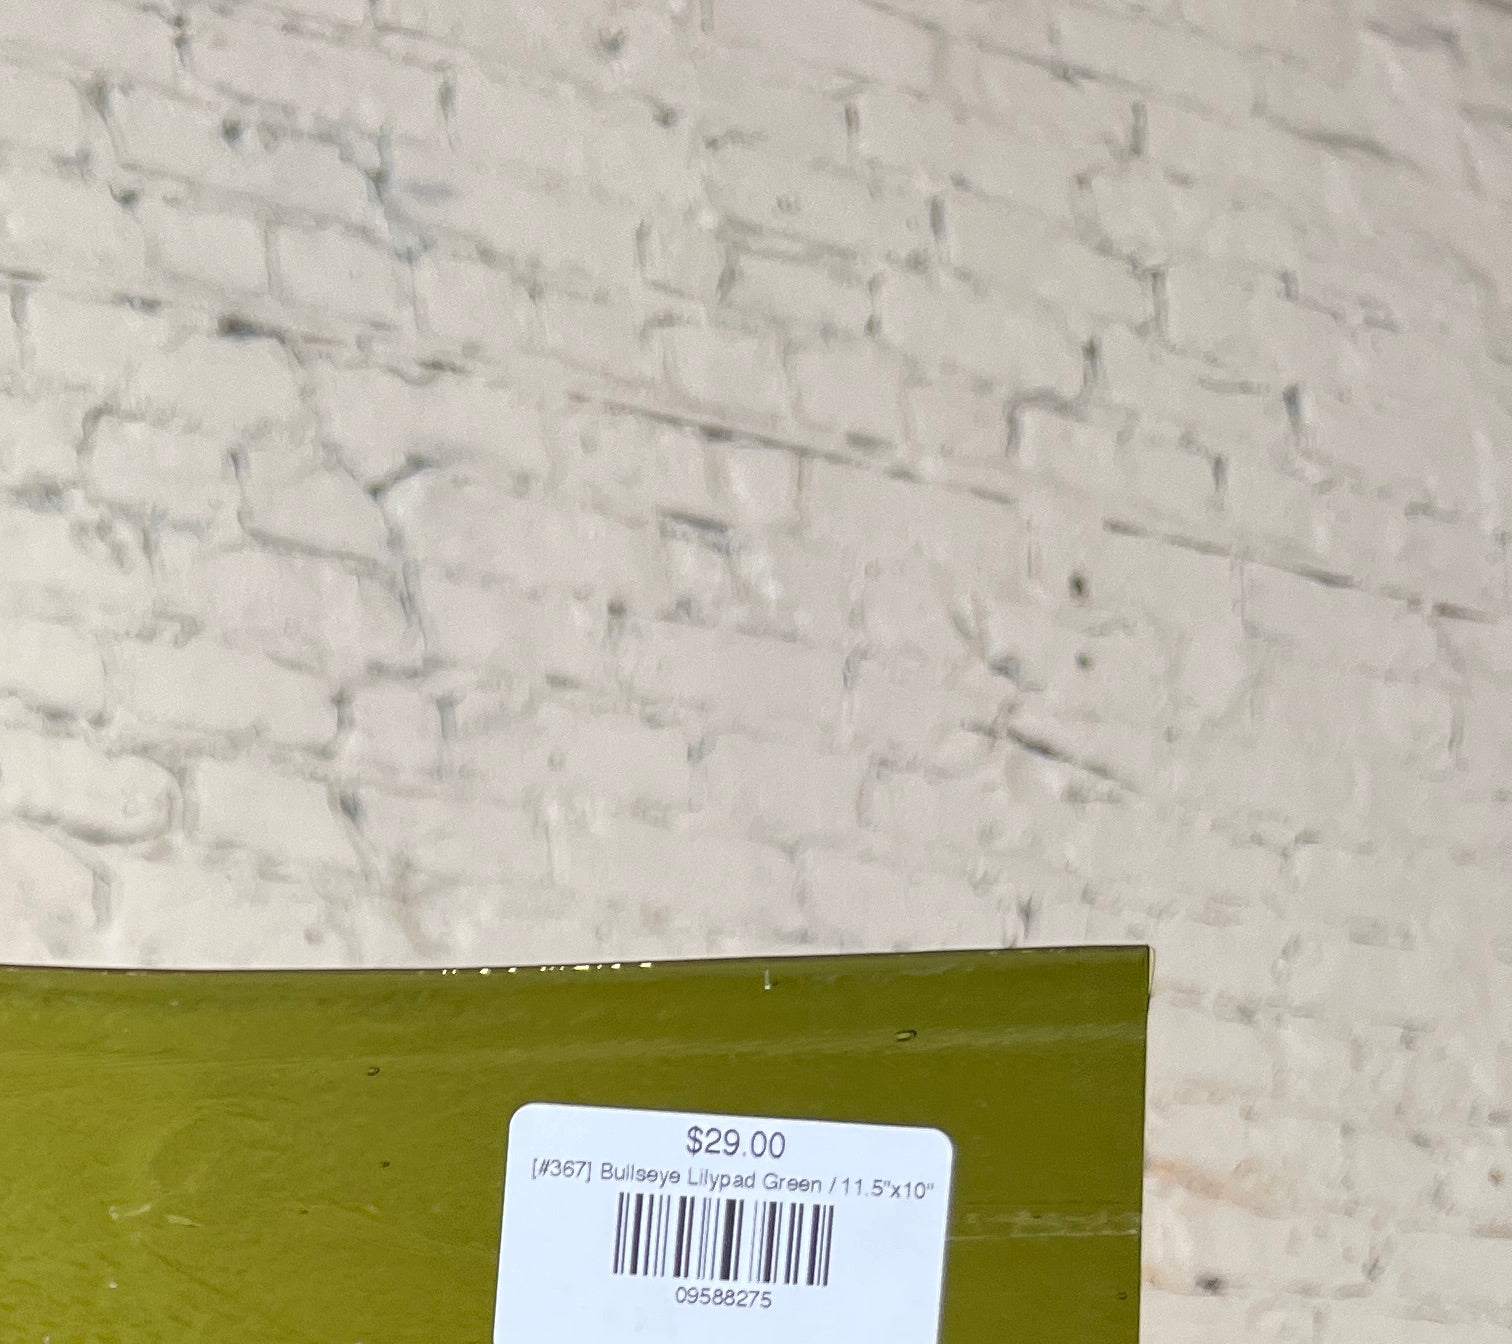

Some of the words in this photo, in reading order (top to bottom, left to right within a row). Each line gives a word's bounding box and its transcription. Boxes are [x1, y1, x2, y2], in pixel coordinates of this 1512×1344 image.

[686, 1125, 786, 1159] $29.00
[531, 1157, 593, 1184] [#367]
[600, 1162, 681, 1189] Bullseye
[687, 1167, 756, 1193] Lilypad
[763, 1172, 822, 1193] Green
[828, 1177, 837, 1195] /
[675, 1286, 773, 1309] 09588275
